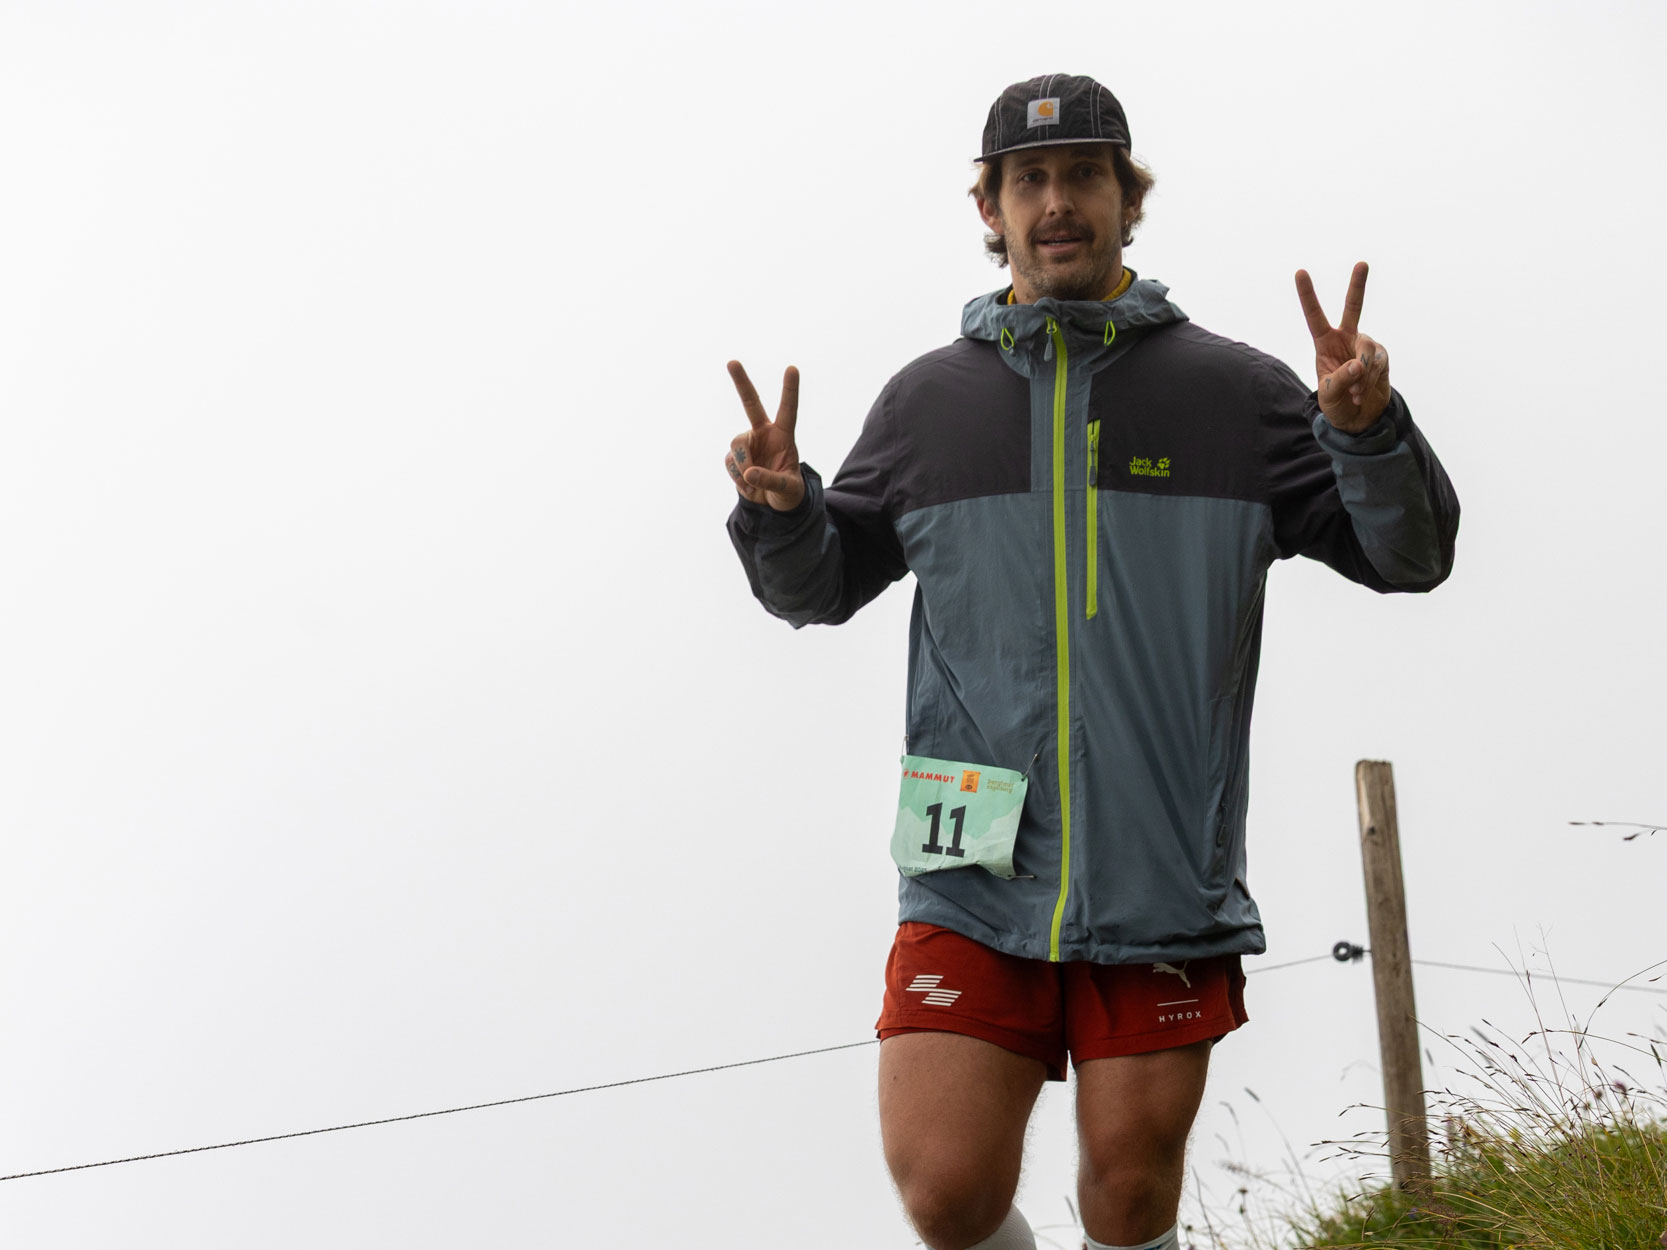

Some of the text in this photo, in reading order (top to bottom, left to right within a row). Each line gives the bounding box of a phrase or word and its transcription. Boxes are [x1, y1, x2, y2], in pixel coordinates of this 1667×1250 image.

[1130, 456, 1152, 467] Jack
[1130, 465, 1170, 477] Wolfskin
[911, 770, 955, 784] MAMMUT
[922, 802, 967, 858] 11
[1158, 1010, 1202, 1023] HYROX
